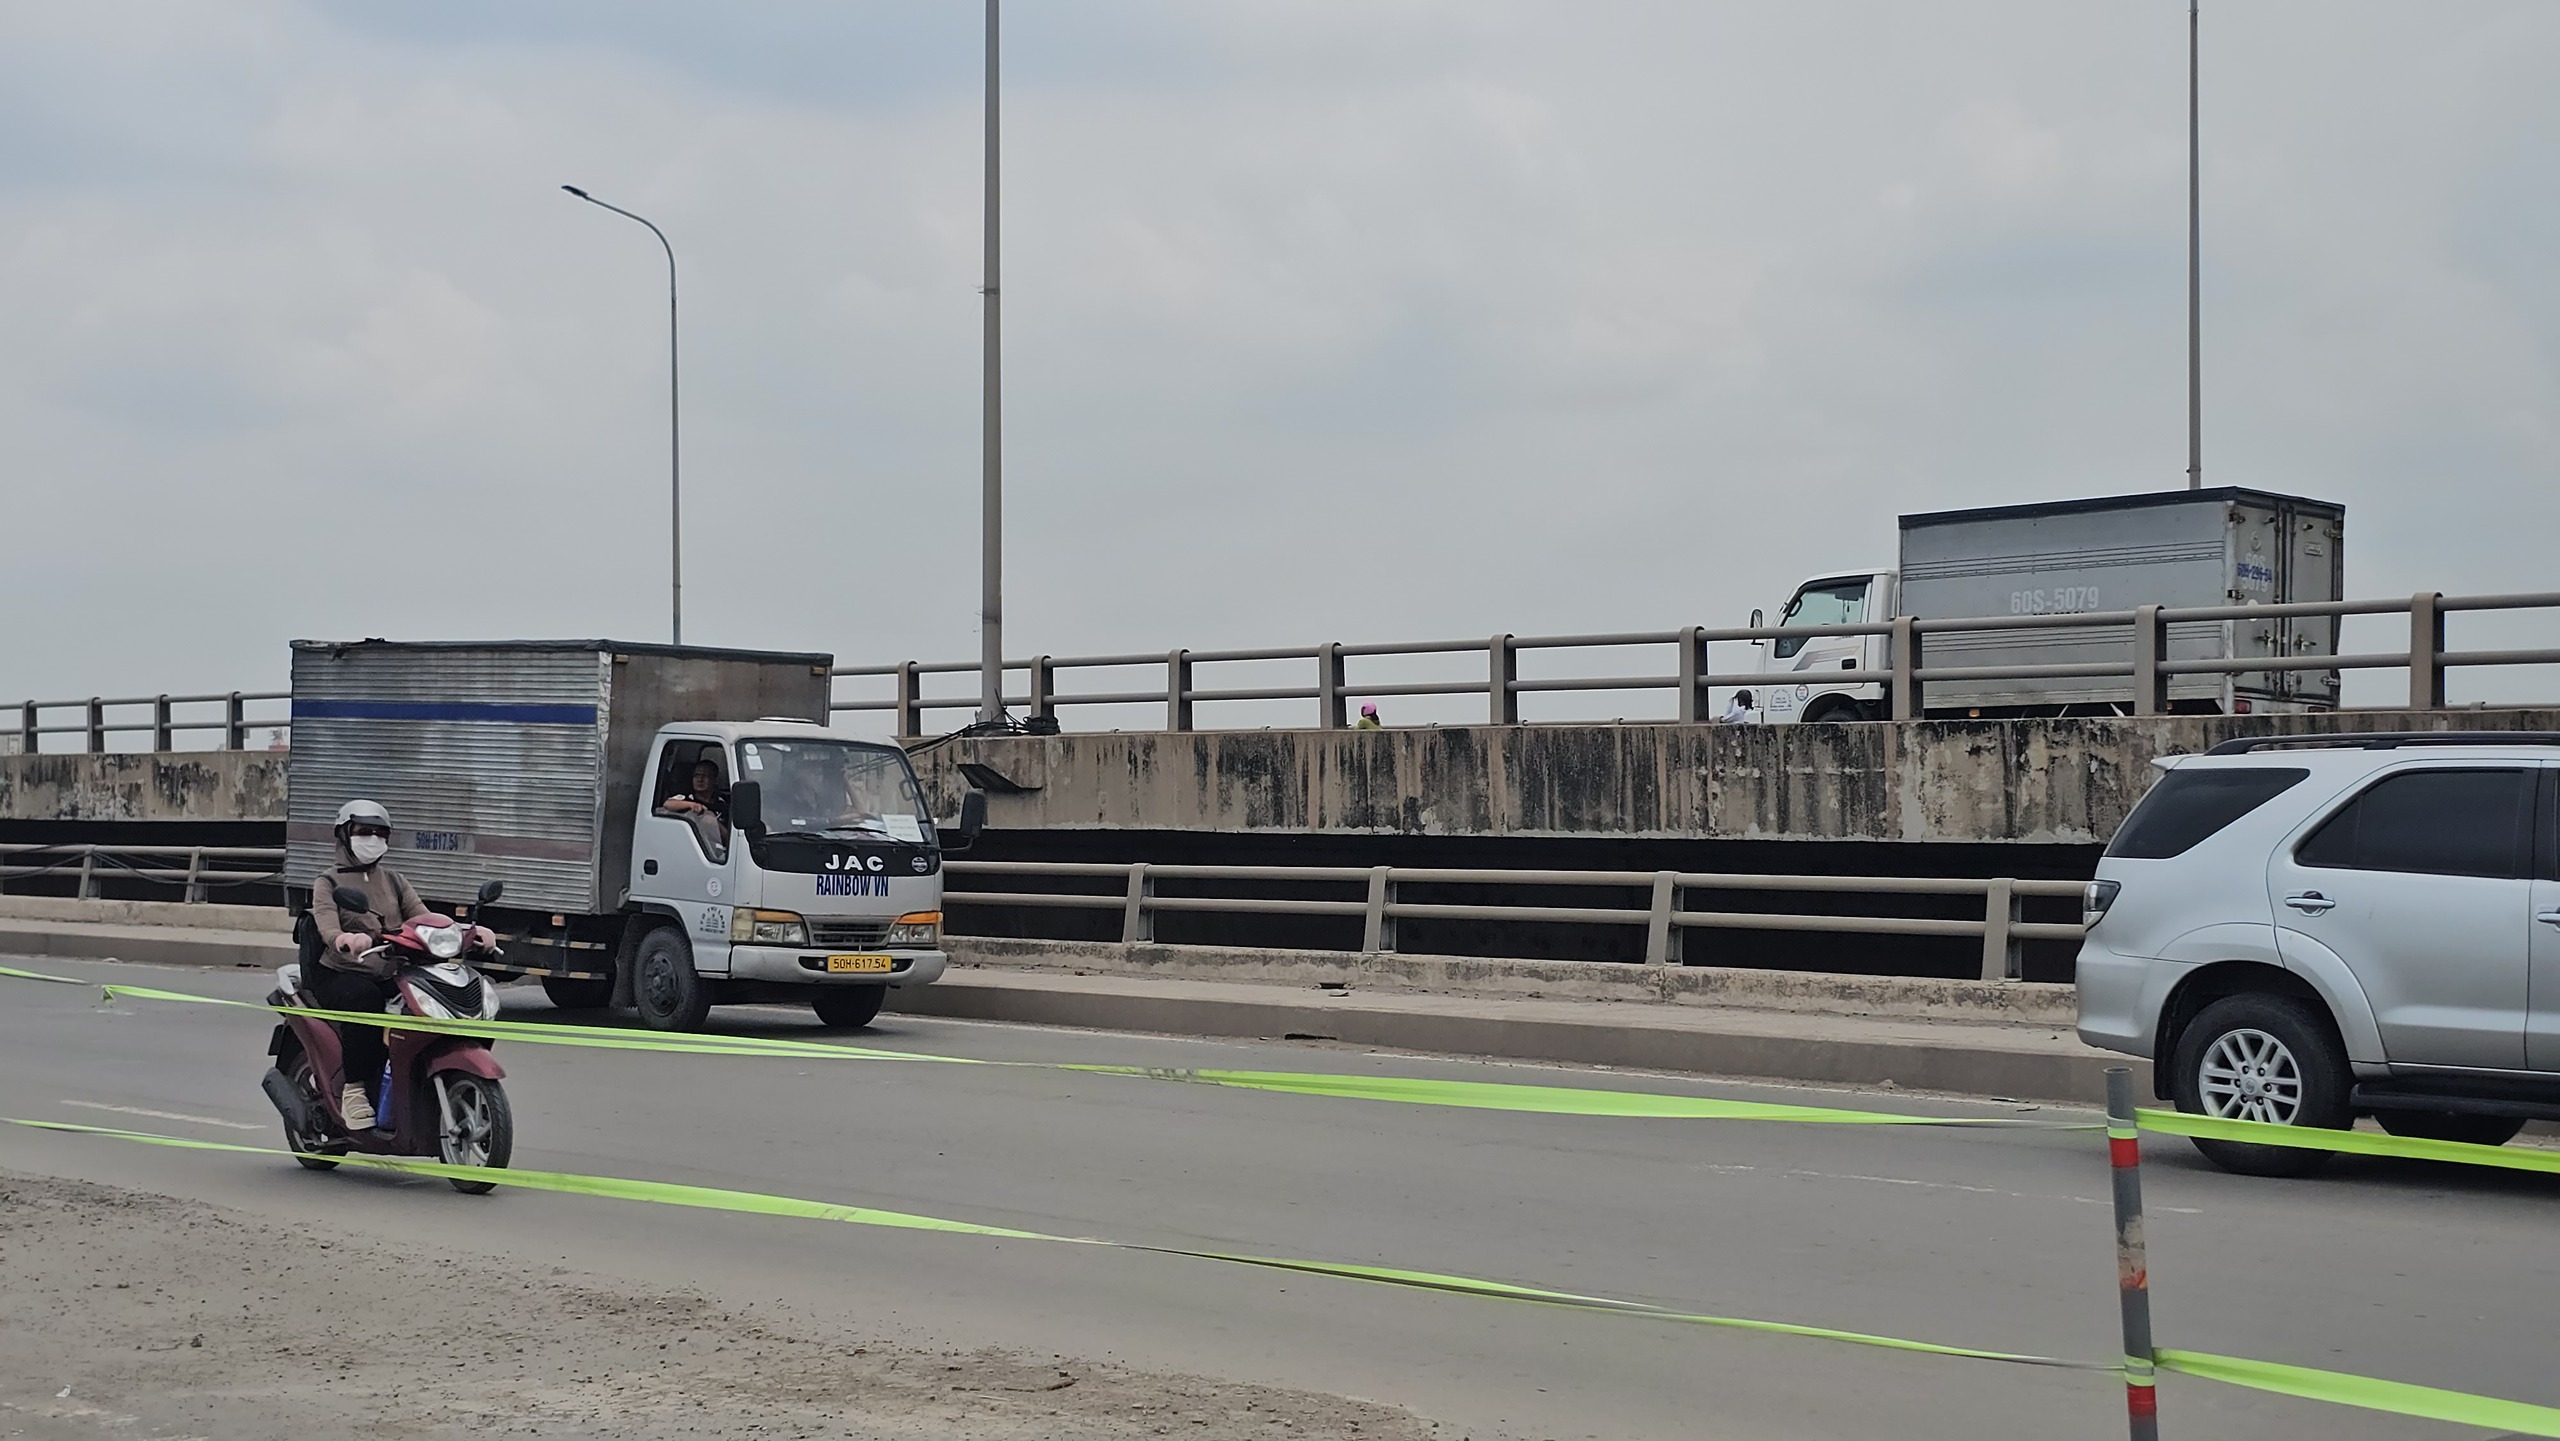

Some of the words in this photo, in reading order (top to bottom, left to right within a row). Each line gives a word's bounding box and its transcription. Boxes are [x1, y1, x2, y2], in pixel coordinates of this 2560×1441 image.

[2011, 586, 2099, 614] 60S-5079
[824, 854, 884, 871] JAC
[816, 874, 871, 896] RAINBOW
[873, 875, 889, 897] VN
